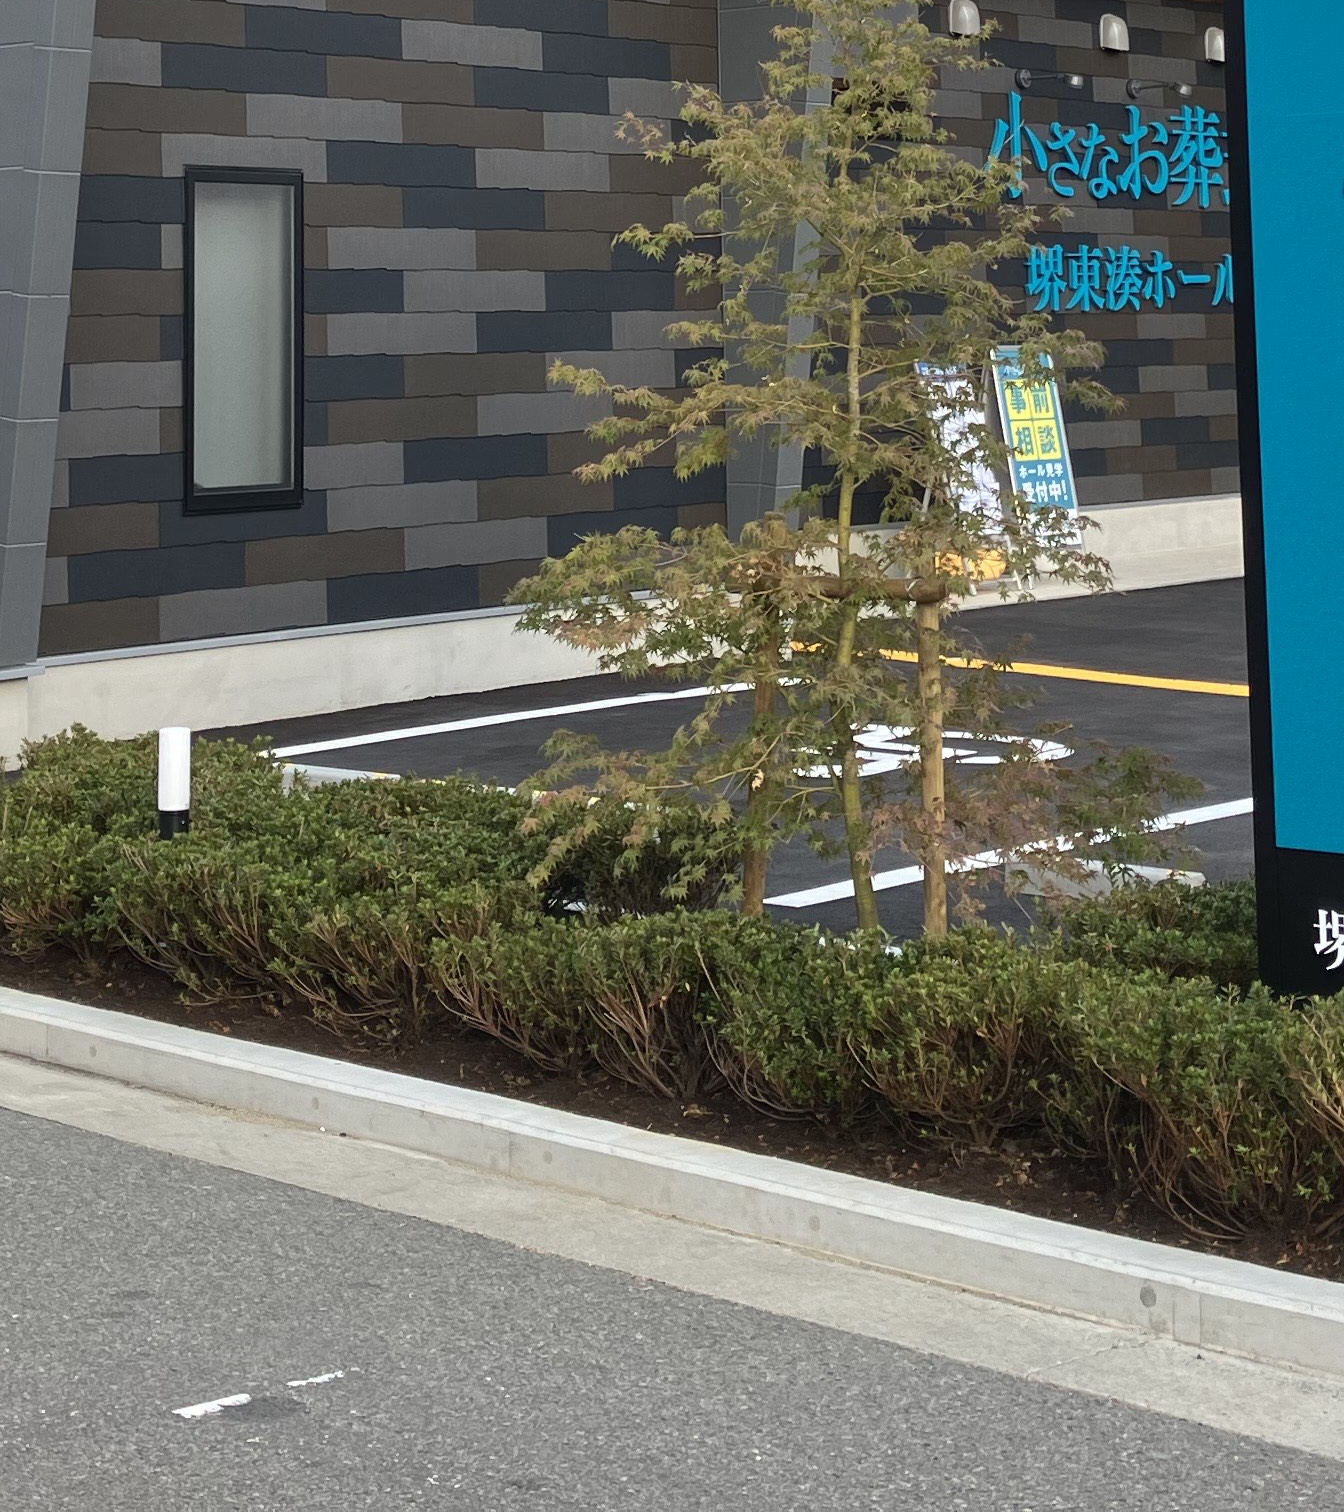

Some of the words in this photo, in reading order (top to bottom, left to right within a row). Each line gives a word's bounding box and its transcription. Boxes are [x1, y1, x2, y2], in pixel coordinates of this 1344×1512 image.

[984, 90, 1230, 208] 小さなお葬
